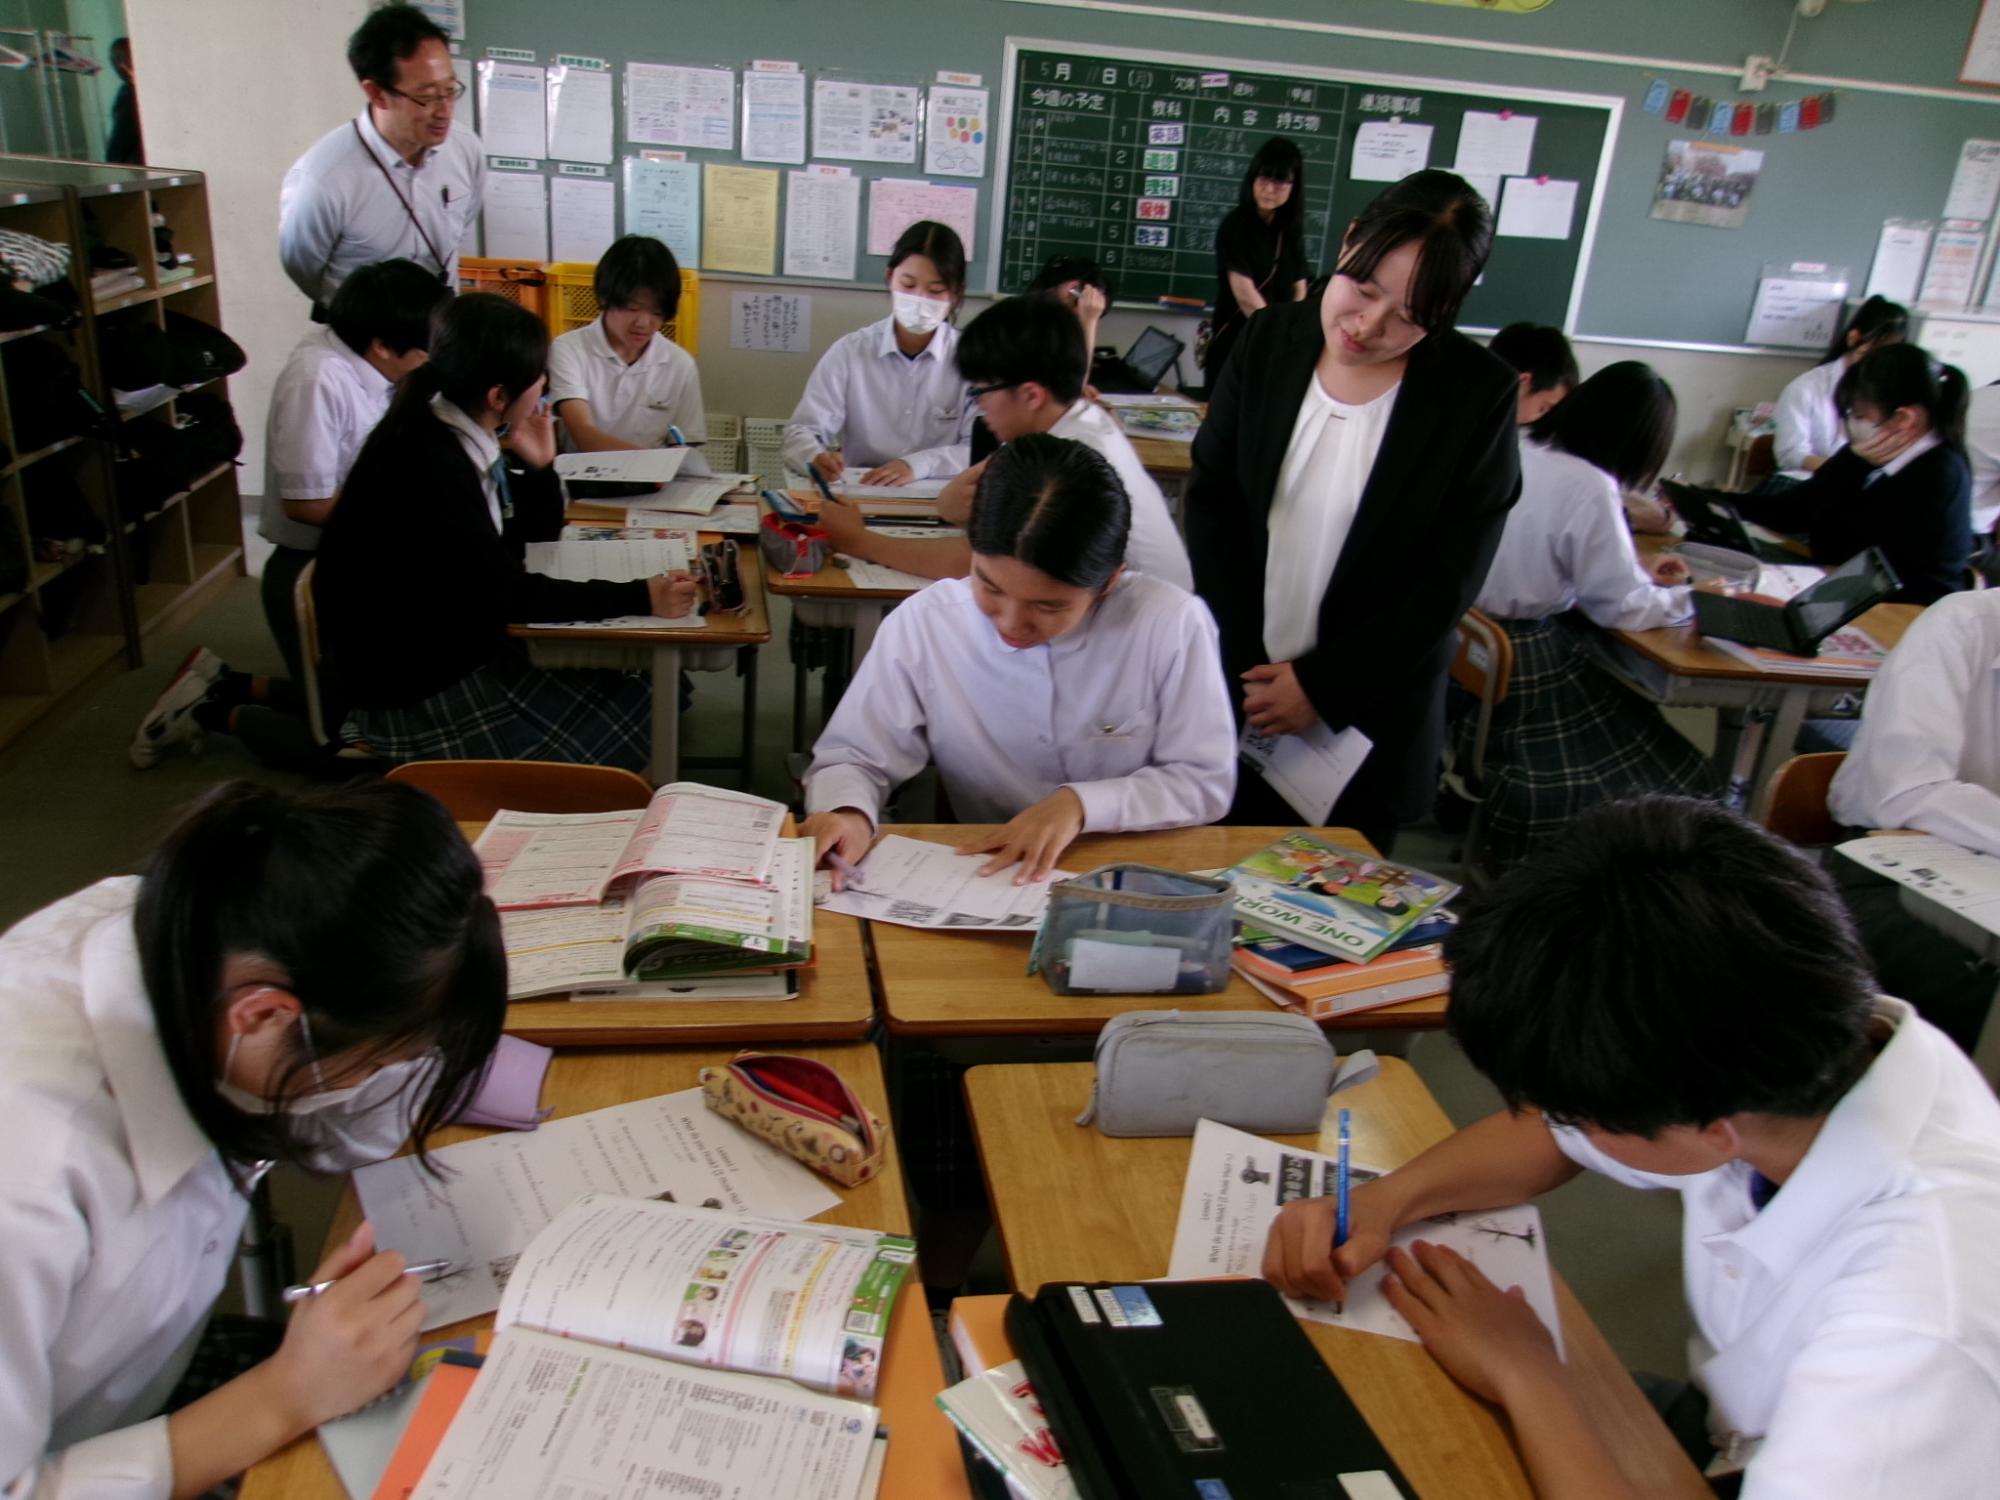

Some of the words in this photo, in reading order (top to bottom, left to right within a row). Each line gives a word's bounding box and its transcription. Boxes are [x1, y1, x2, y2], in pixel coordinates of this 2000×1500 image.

[1032, 88, 1104, 110] 今週の予定
[1359, 93, 1422, 115] 連絡事項
[1152, 100, 1182, 117] 教科
[1276, 112, 1321, 131] 持ち物
[1151, 126, 1181, 142] 英語
[1115, 151, 1127, 163] 2
[1113, 176, 1124, 188] 3
[1110, 201, 1120, 213] 4
[1109, 226, 1119, 238] 5
[1136, 228, 1163, 245] 数学
[1235, 896, 1302, 924] WORL
[1306, 920, 1364, 946] ONE
